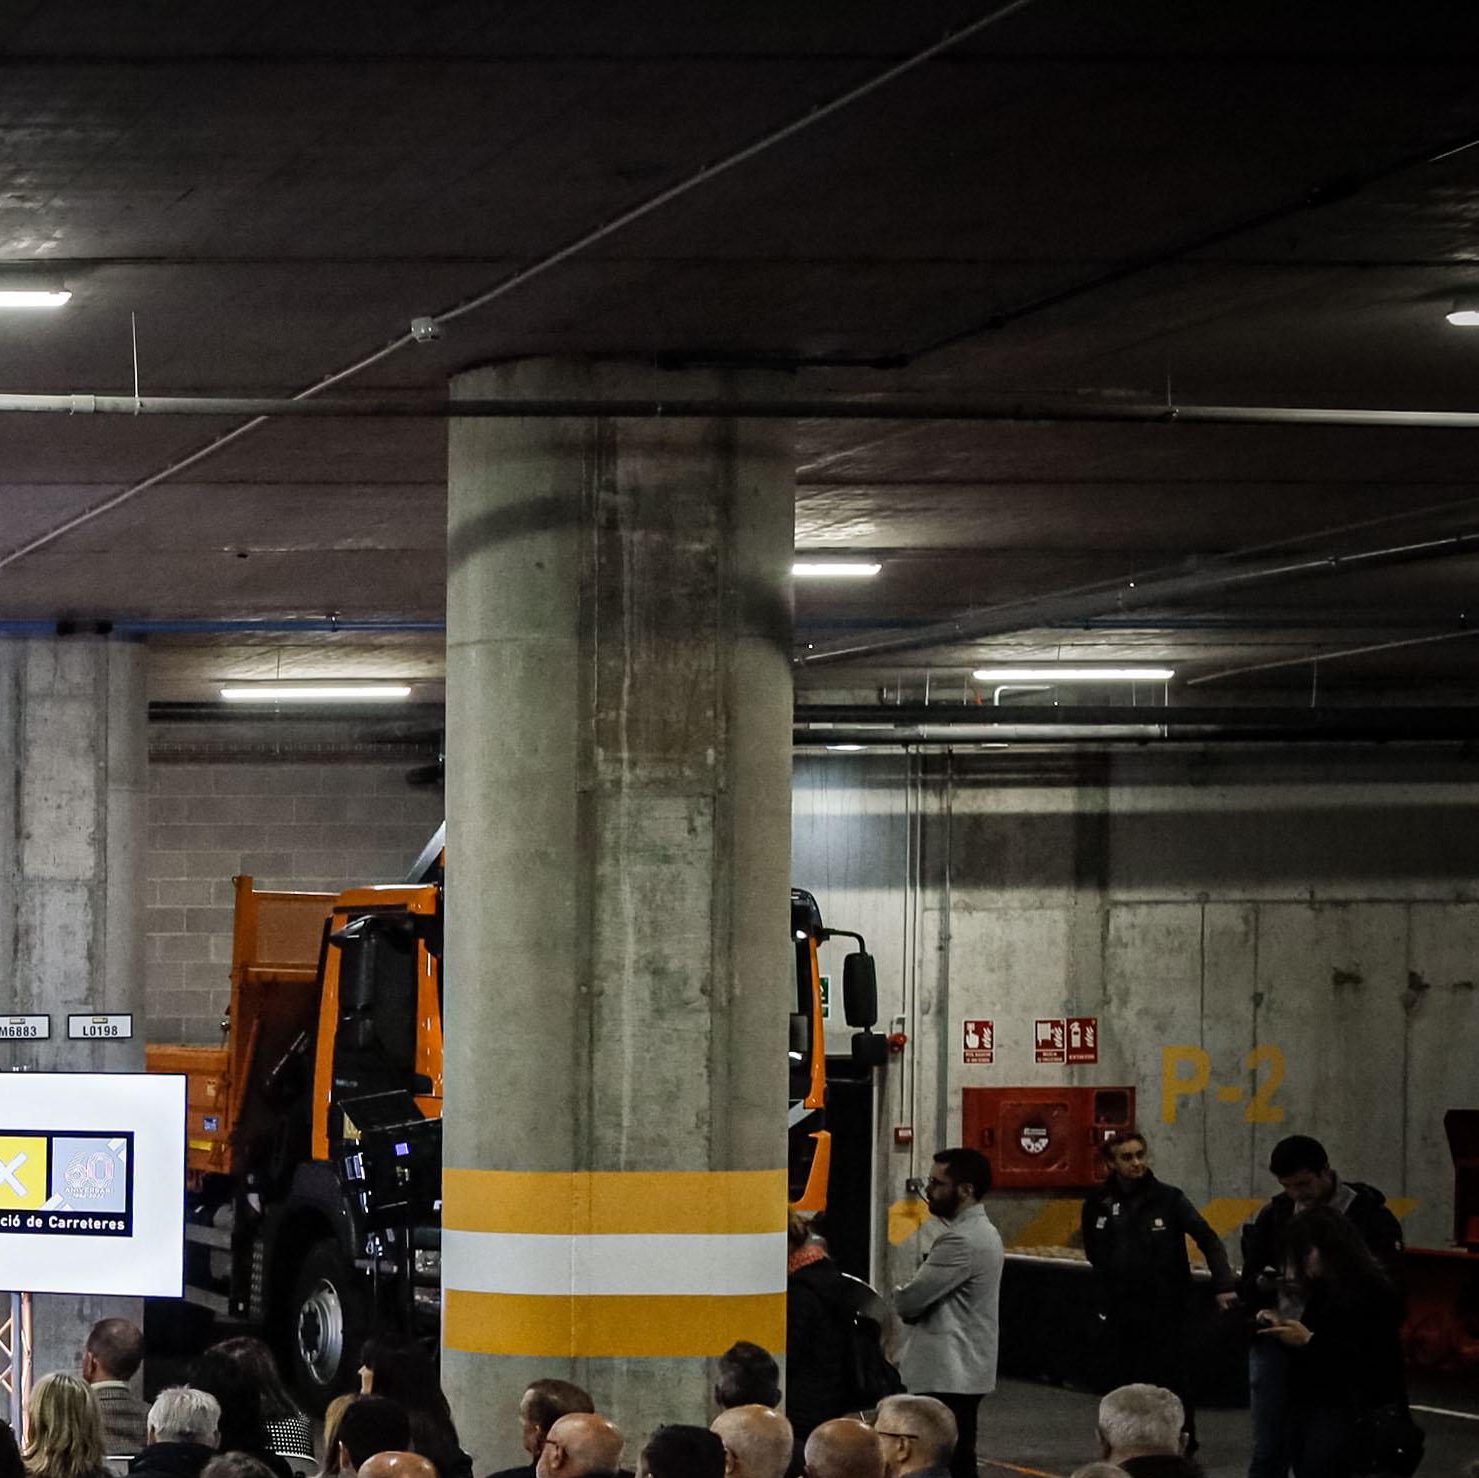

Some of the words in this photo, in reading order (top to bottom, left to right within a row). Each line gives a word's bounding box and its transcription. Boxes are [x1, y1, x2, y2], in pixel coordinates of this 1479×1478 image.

[83, 1025, 118, 1036] L0198
[1162, 1045, 1286, 1124] P-2
[65, 1151, 114, 1189] 60
[26, 1215, 43, 1228] de
[48, 1216, 125, 1231] Carreteres
